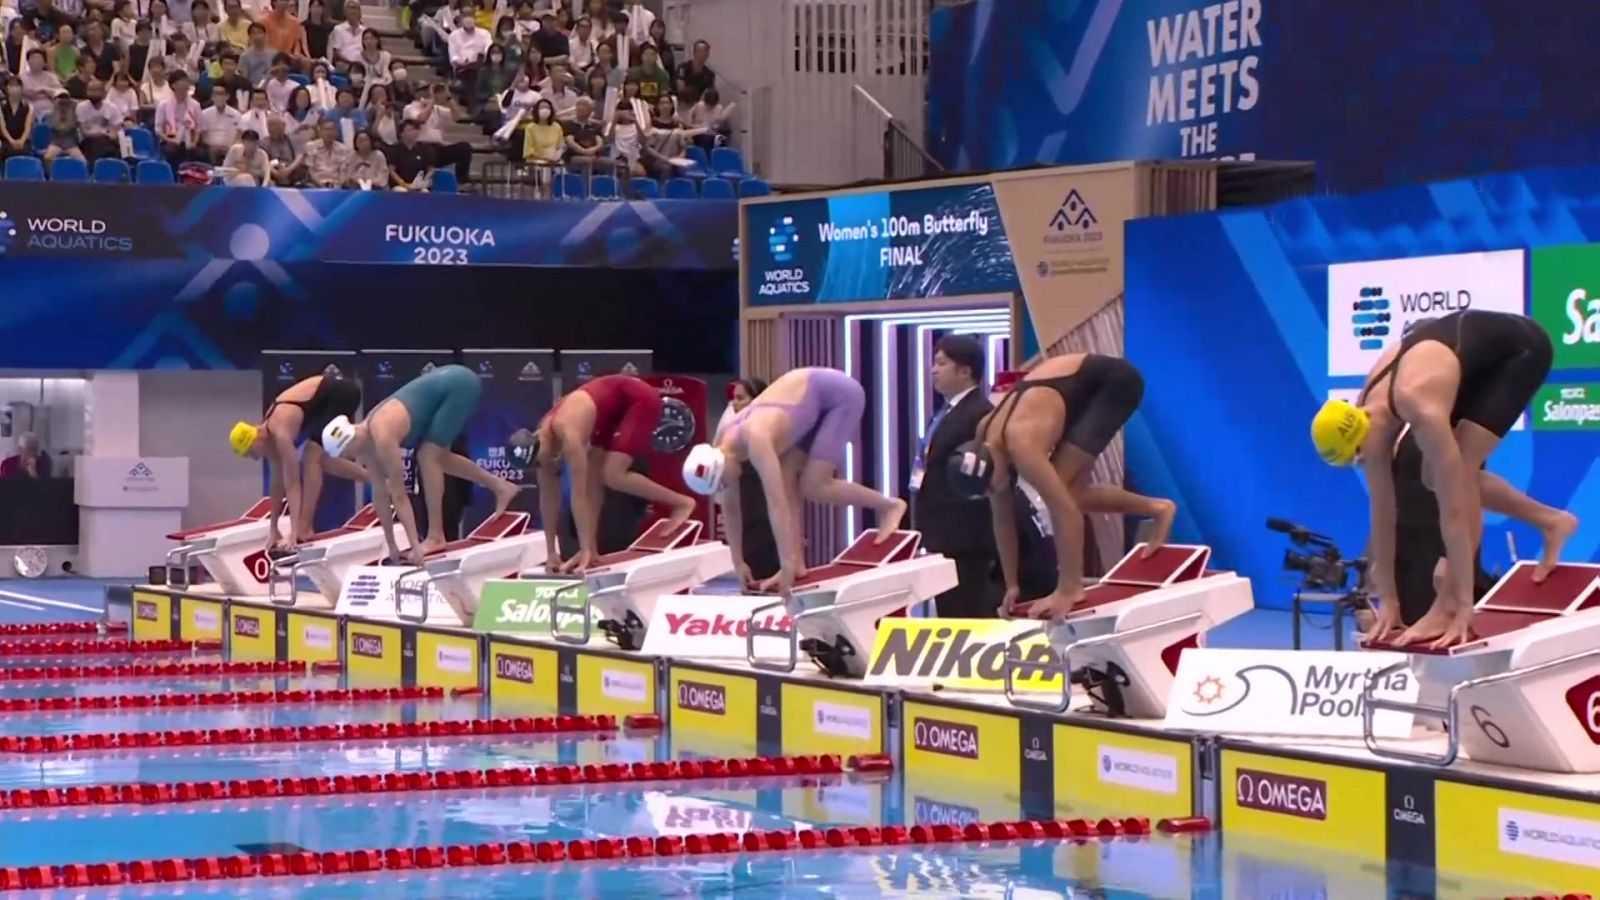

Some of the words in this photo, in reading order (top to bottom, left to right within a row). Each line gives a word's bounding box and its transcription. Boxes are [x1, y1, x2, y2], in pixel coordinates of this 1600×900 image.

[1146, 0, 1262, 67] WATER
[1146, 56, 1259, 126] MEETS
[1180, 122, 1218, 157] THE
[27, 218, 106, 233] WORLD
[385, 224, 496, 247] FUKUOKA
[818, 219, 879, 242] Women's
[880, 216, 921, 238] 100m
[923, 209, 988, 237] Butterfly
[27, 234, 133, 251] AQUATICS
[414, 247, 468, 265] 2023
[879, 245, 922, 268] FINAL
[764, 268, 804, 281] WORLD
[758, 281, 810, 295] AQUATICS
[1400, 289, 1471, 312] WORLD
[1337, 411, 1356, 438] AUS
[477, 459, 510, 469] FUKU
[254, 557, 269, 579] 0
[496, 599, 605, 628] Salops
[869, 627, 1065, 682] Nikon
[505, 658, 533, 680] OMEGA
[688, 685, 725, 711] OMEGA
[1299, 693, 1373, 718] Pool
[1470, 705, 1510, 748] 6
[930, 726, 977, 754] OMEGA
[1258, 783, 1325, 815] OMEGA
[1393, 807, 1426, 825] OMEGA
